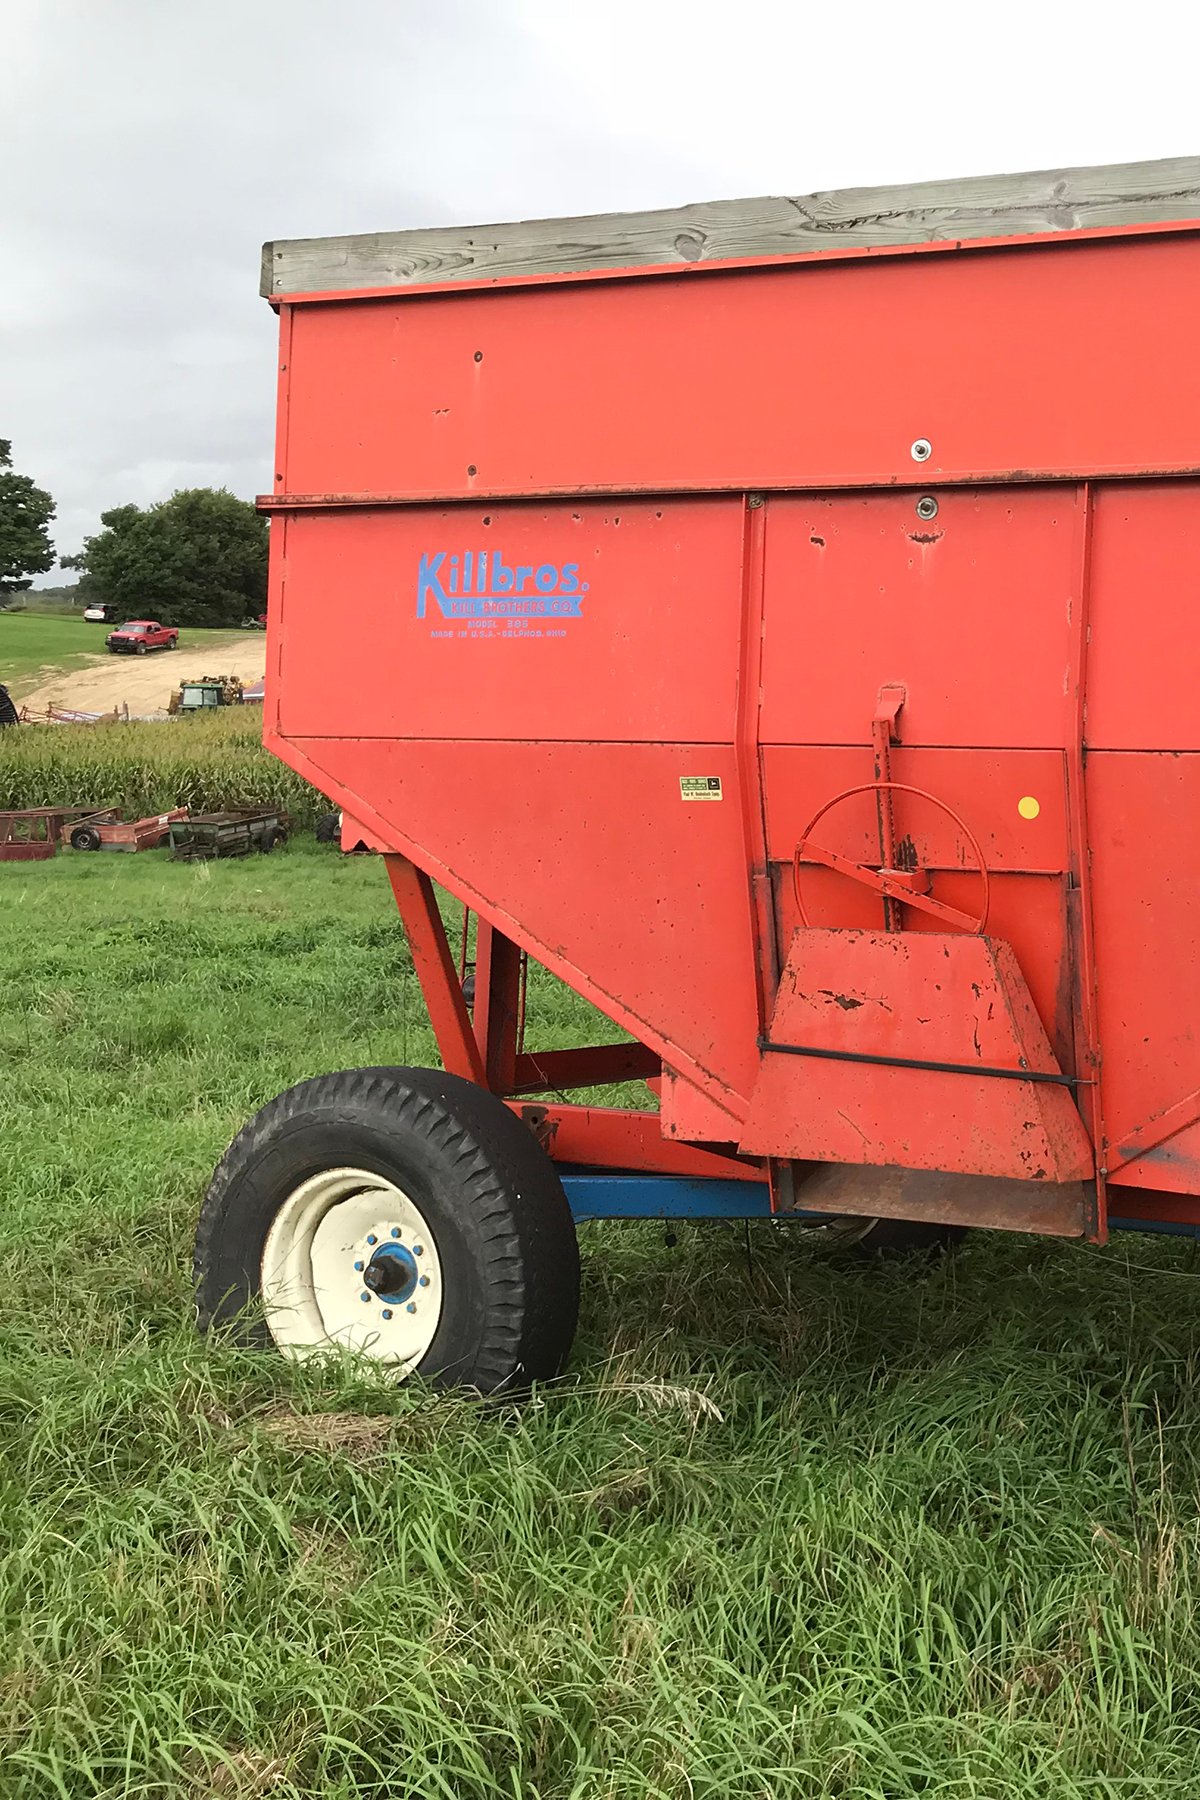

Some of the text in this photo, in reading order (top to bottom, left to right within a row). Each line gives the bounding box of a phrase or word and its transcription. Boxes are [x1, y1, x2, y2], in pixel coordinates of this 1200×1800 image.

[451, 602, 475, 614] KILL
[483, 601, 545, 614] BROTHERS
[468, 620, 497, 628] MODEL
[431, 630, 454, 638] MADE
[458, 630, 467, 638] IN
